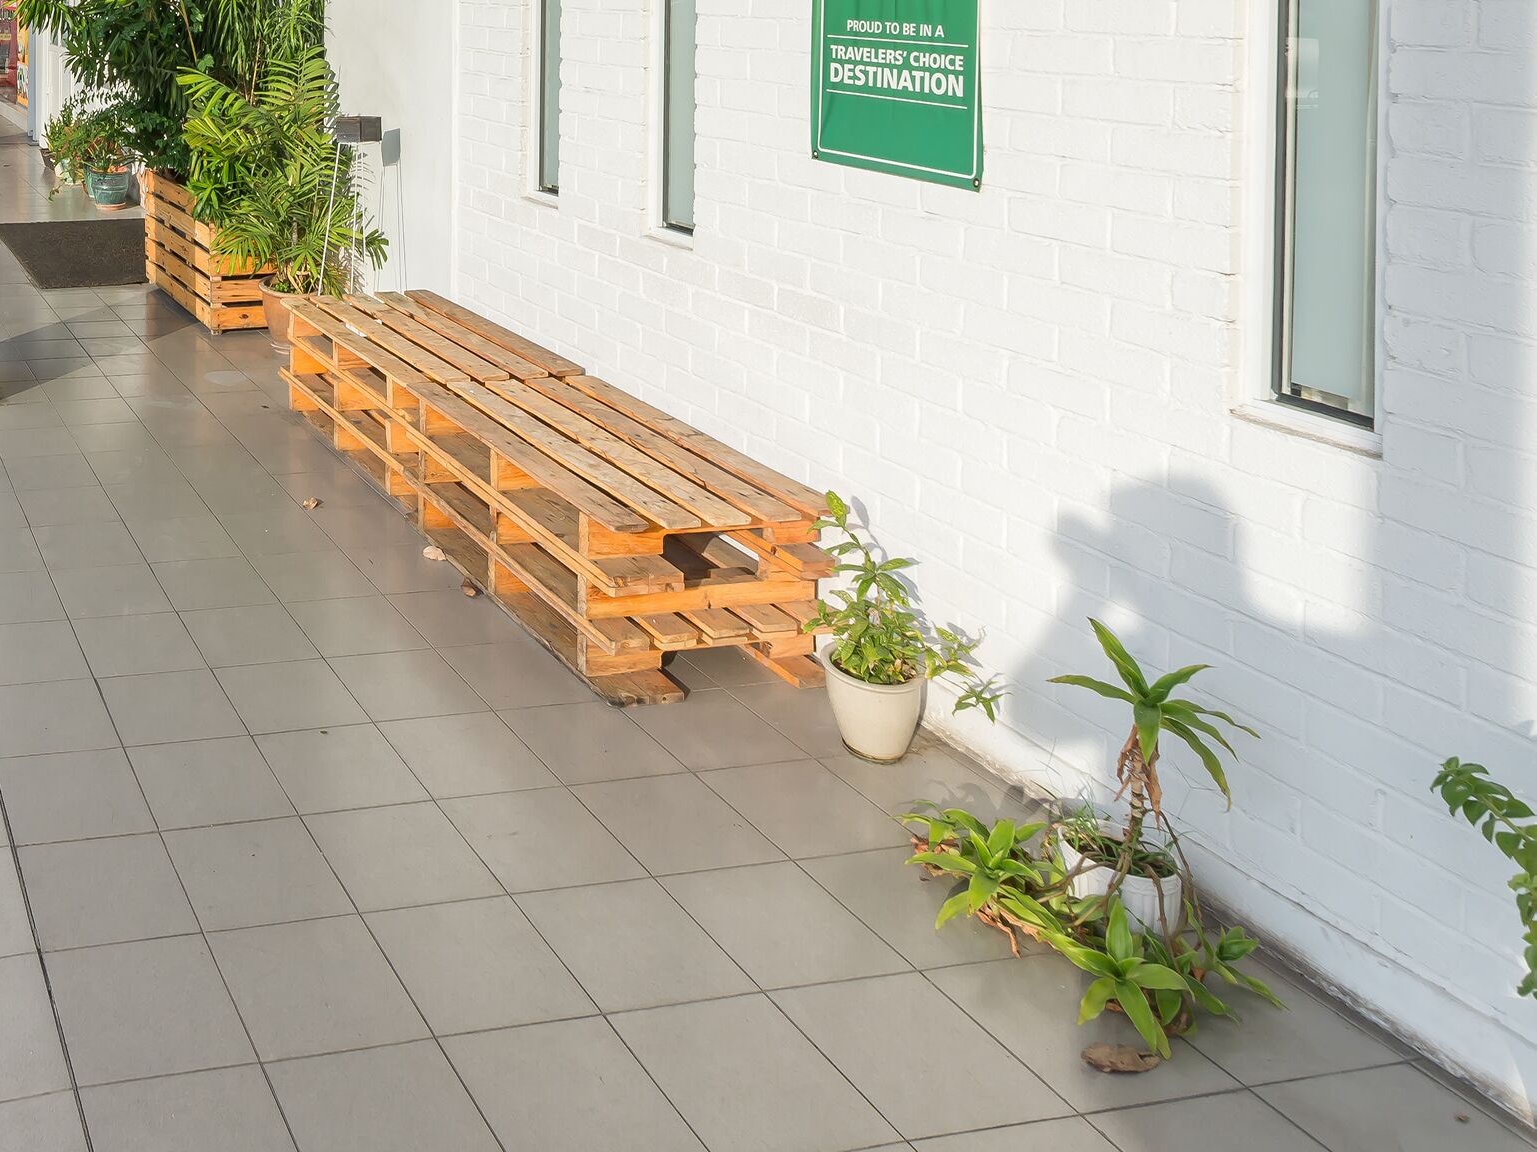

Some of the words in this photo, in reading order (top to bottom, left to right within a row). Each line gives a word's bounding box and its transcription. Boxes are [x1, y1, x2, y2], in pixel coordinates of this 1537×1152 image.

[846, 19, 883, 34] PROUD
[884, 21, 900, 35] TO
[902, 22, 916, 36] BE
[919, 23, 932, 37] IN
[934, 25, 945, 38] A
[909, 51, 964, 71] CHOICE
[829, 62, 964, 97] DESTINATION
